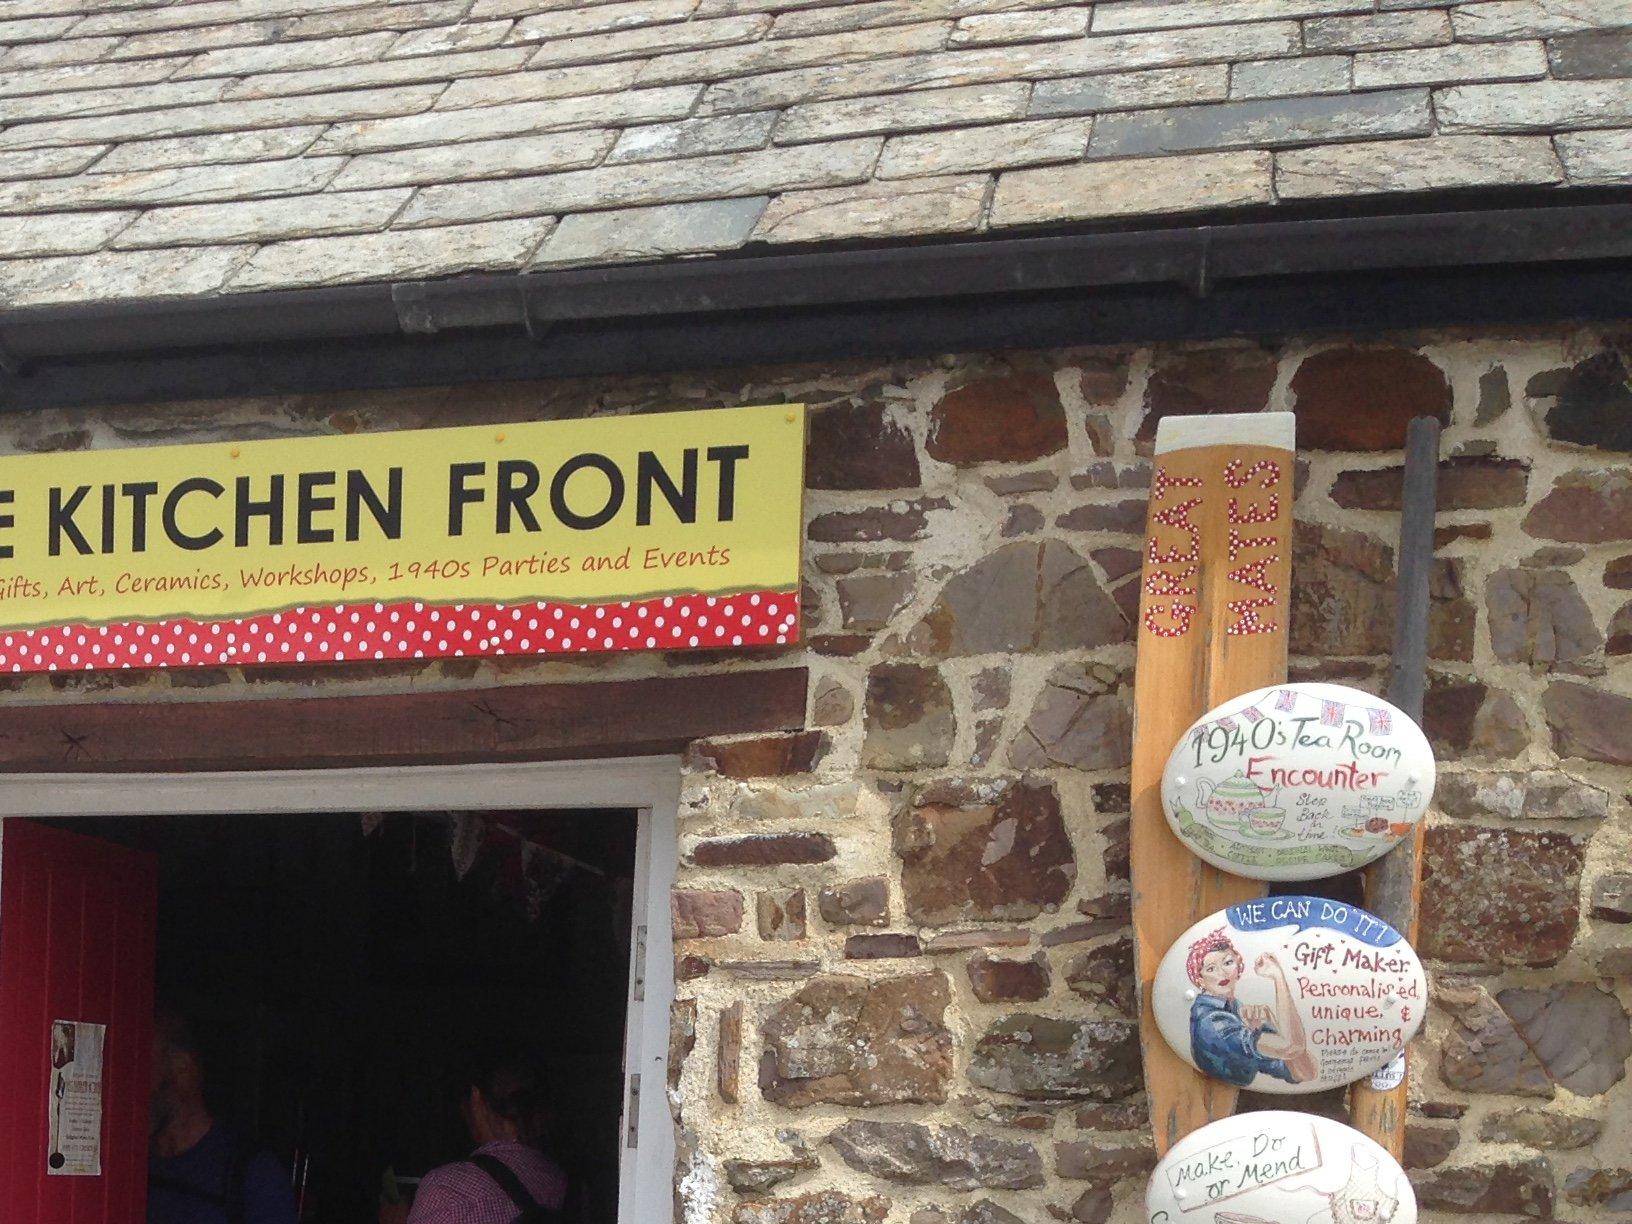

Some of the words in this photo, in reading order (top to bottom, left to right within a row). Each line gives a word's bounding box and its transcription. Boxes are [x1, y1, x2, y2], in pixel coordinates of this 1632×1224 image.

[49, 467, 403, 556] KITCHEN
[448, 444, 749, 537] FRONT
[58, 576, 105, 597] Art,
[115, 569, 229, 594] Ceramics,
[240, 562, 376, 590] Workshops,
[388, 560, 470, 581] 1940s
[482, 551, 570, 577] Parties
[582, 547, 631, 571] and
[644, 545, 731, 568] Events
[1290, 717, 1332, 749] Tea
[1339, 720, 1402, 766] Room
[1246, 756, 1389, 792] Encounter
[1235, 903, 1266, 926] WE
[1271, 901, 1312, 921] CAN
[1321, 903, 1348, 924] DO
[1294, 942, 1335, 969] Gift
[1253, 1133, 1286, 1157] Do
[1238, 1147, 1305, 1188] Mend
